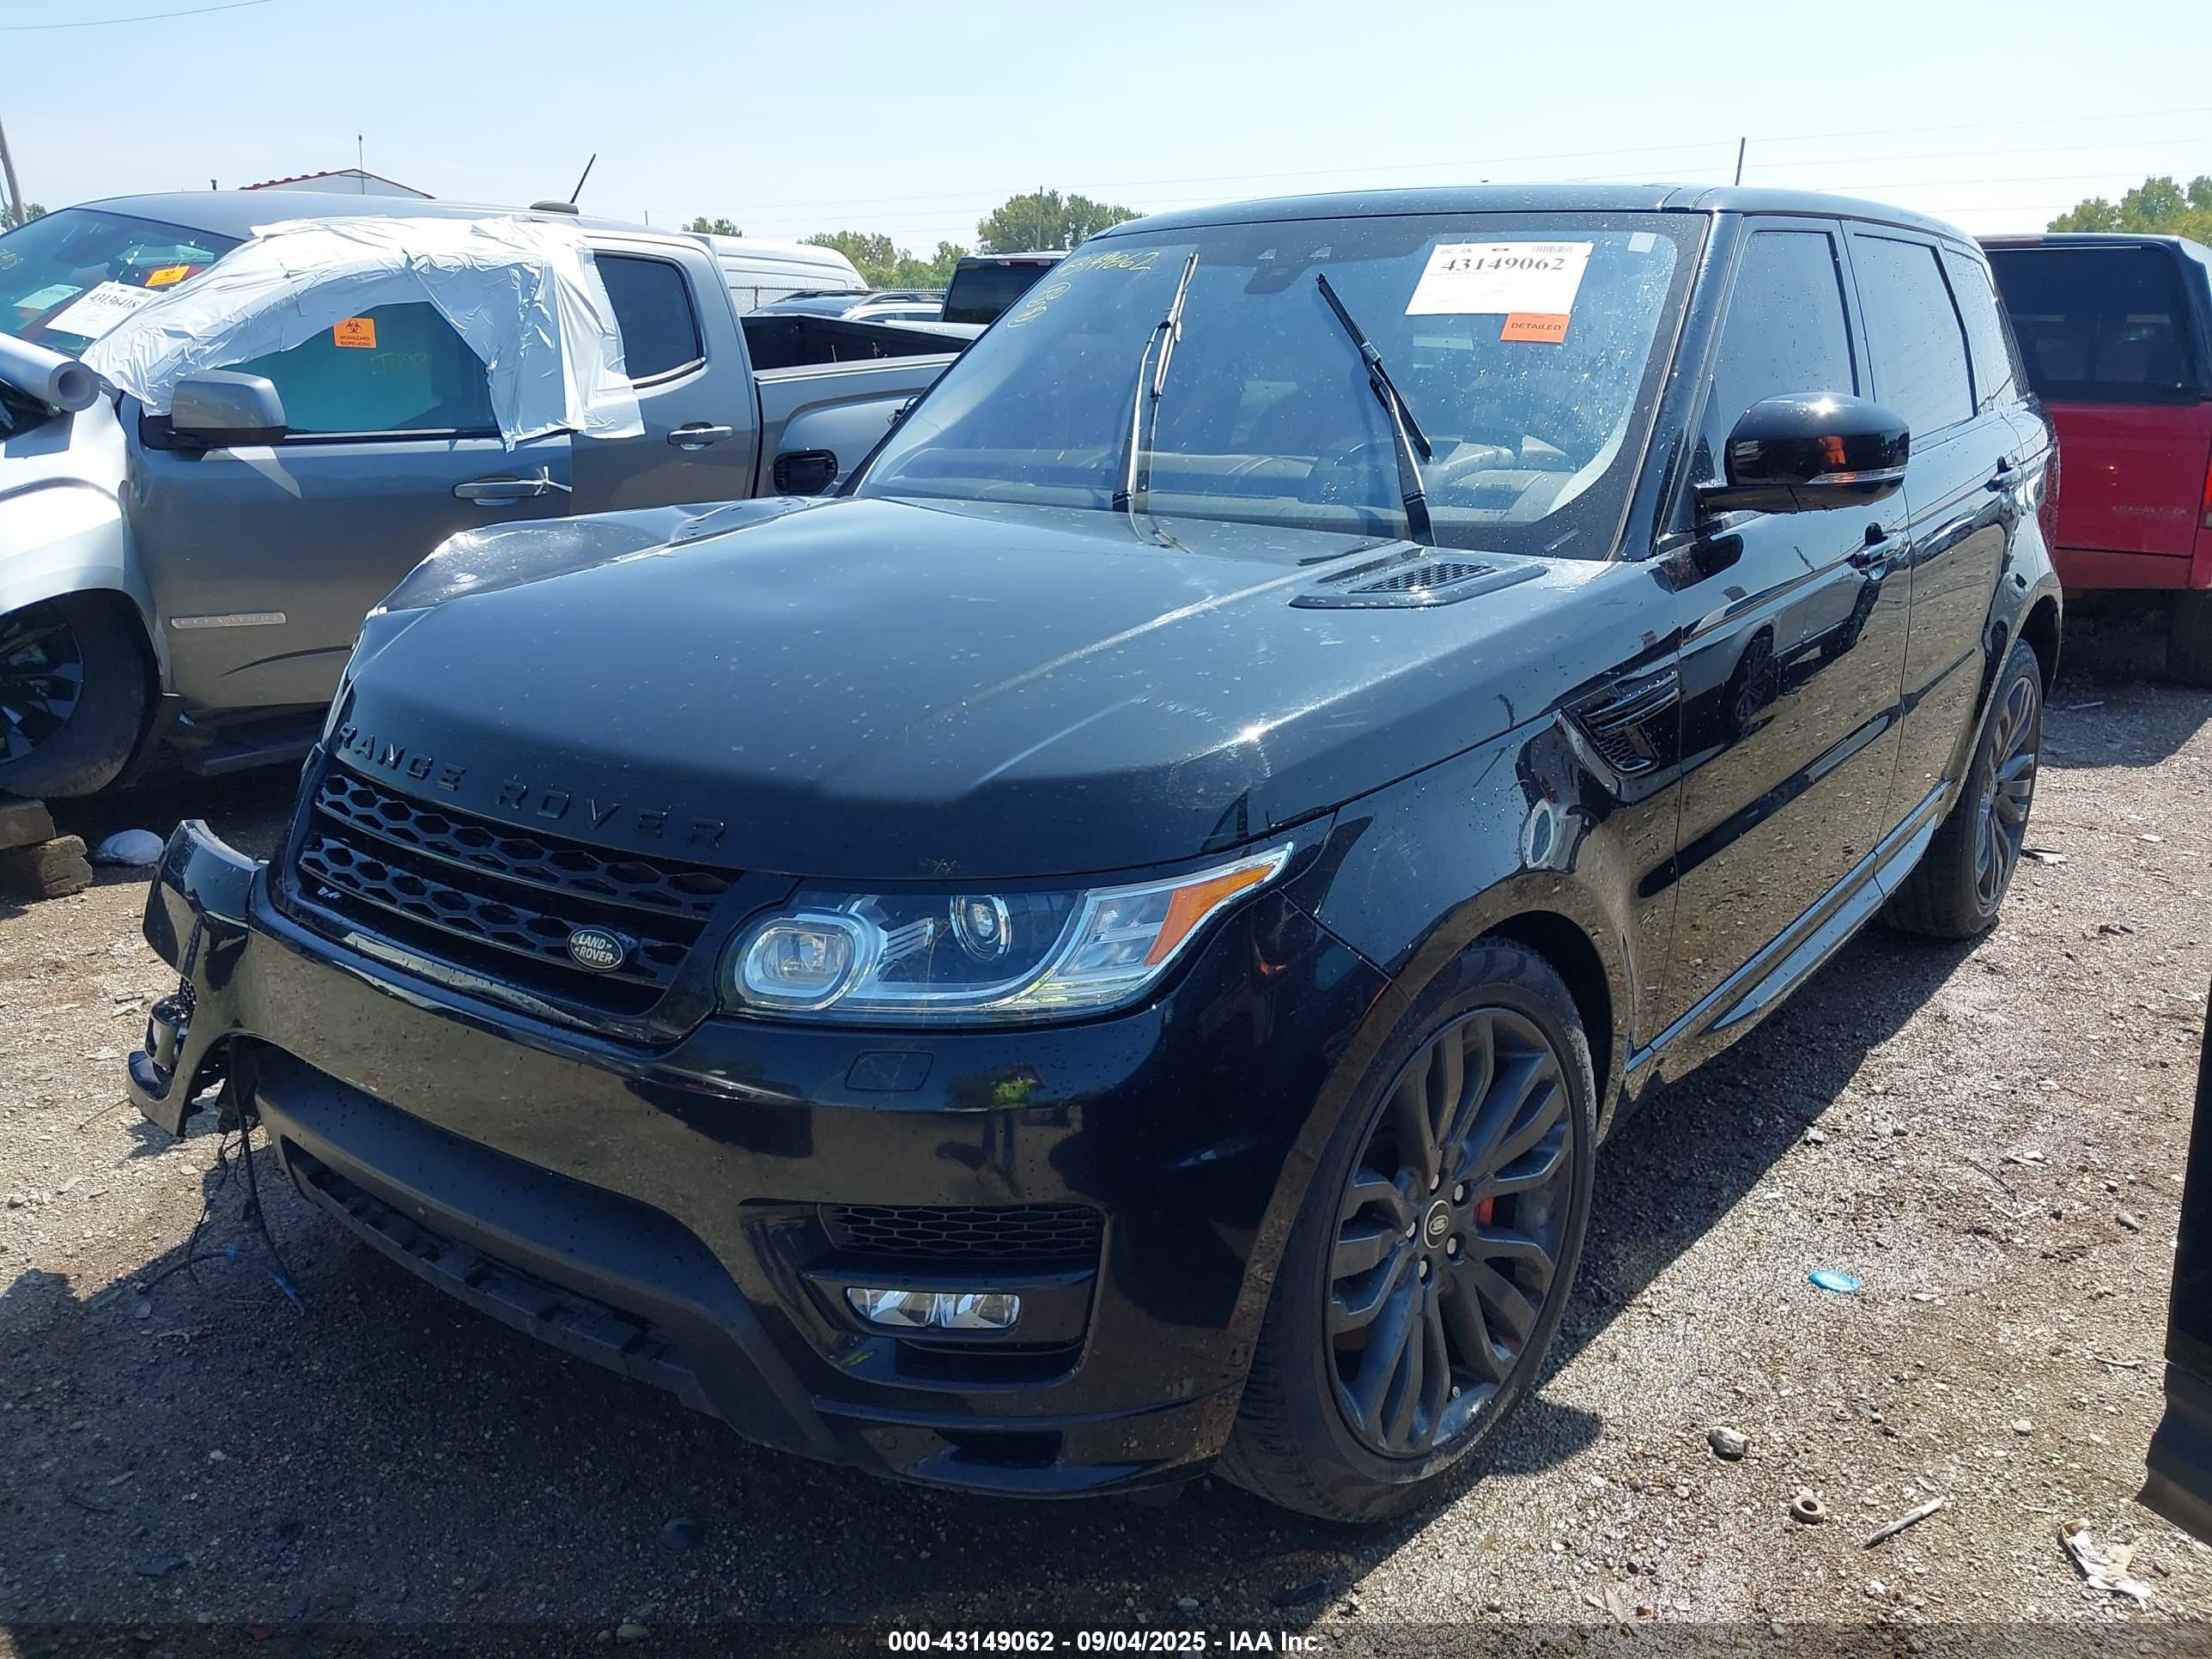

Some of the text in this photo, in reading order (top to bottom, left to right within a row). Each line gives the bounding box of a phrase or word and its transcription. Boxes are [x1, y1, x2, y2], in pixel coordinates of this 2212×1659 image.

[1442, 258, 1565, 271] 43149062
[1510, 322, 1561, 331] DETAILED
[337, 721, 728, 849] RANGE ROVER
[579, 933, 606, 950] LAND
[579, 945, 613, 963] ROVER
